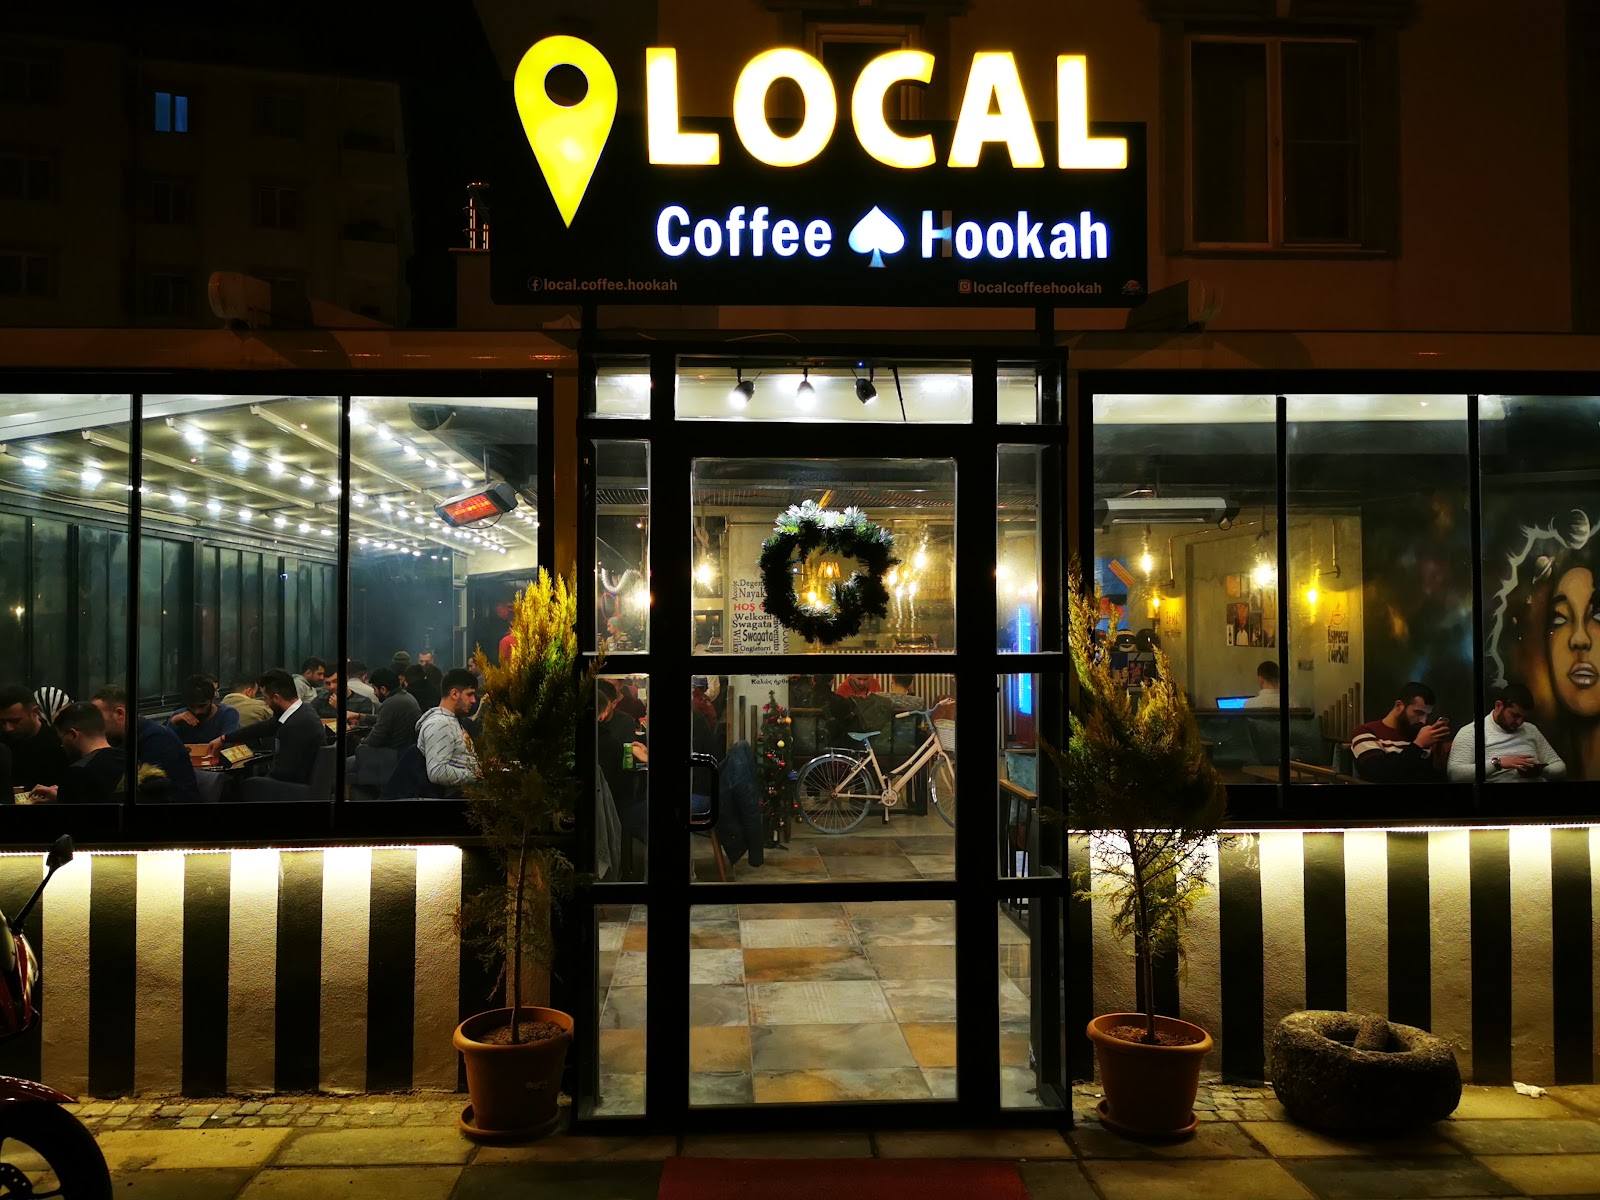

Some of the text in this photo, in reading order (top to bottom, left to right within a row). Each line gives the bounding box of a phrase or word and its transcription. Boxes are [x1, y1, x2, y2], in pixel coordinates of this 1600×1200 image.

[645, 47, 1128, 170] LOCAL
[656, 205, 1109, 260] Coffee Hookah
[543, 278, 678, 291] local.coffee.hookah
[973, 281, 1102, 294] localcoffeehookah
[733, 603, 756, 612] HOŞ
[732, 620, 772, 631] Swagata
